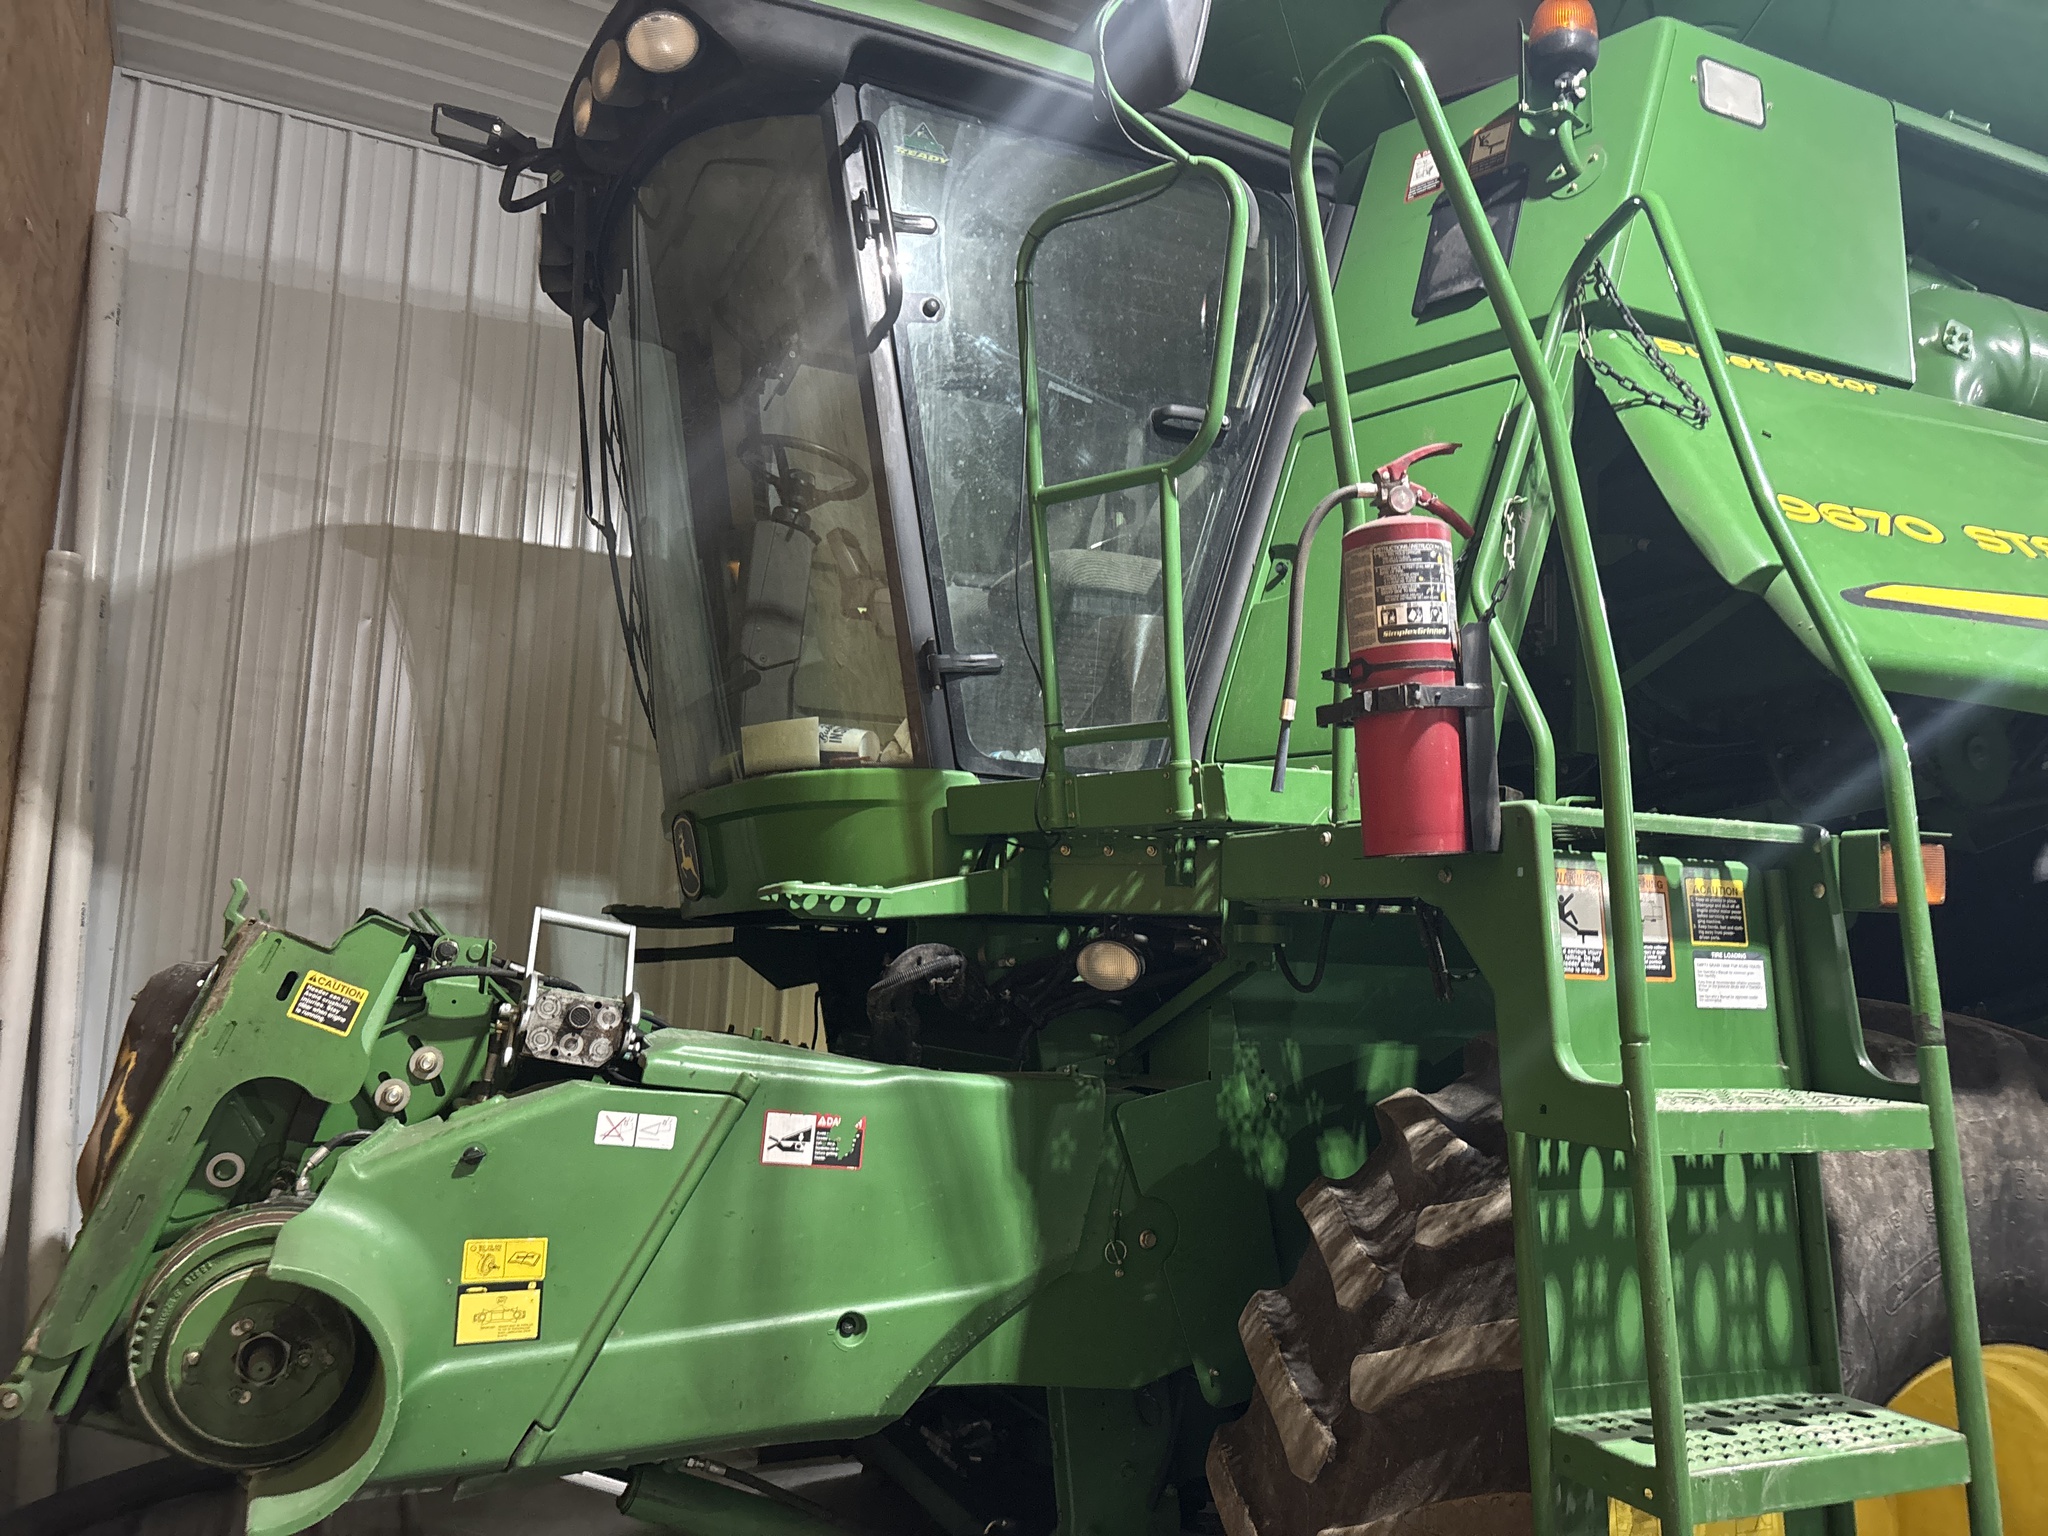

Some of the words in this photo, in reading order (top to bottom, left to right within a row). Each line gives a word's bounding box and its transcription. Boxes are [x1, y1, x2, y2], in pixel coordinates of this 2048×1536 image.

[895, 146, 950, 166] READY
[1653, 337, 1771, 373] Buet
[1775, 361, 1880, 395] Rotor
[1777, 492, 1946, 545] 9670
[1700, 885, 1739, 896] CAUTION
[1724, 952, 1747, 960] LOADING
[317, 976, 365, 1000] CAUTION
[303, 990, 322, 1000] Avoid
[322, 997, 349, 1012] crushing
